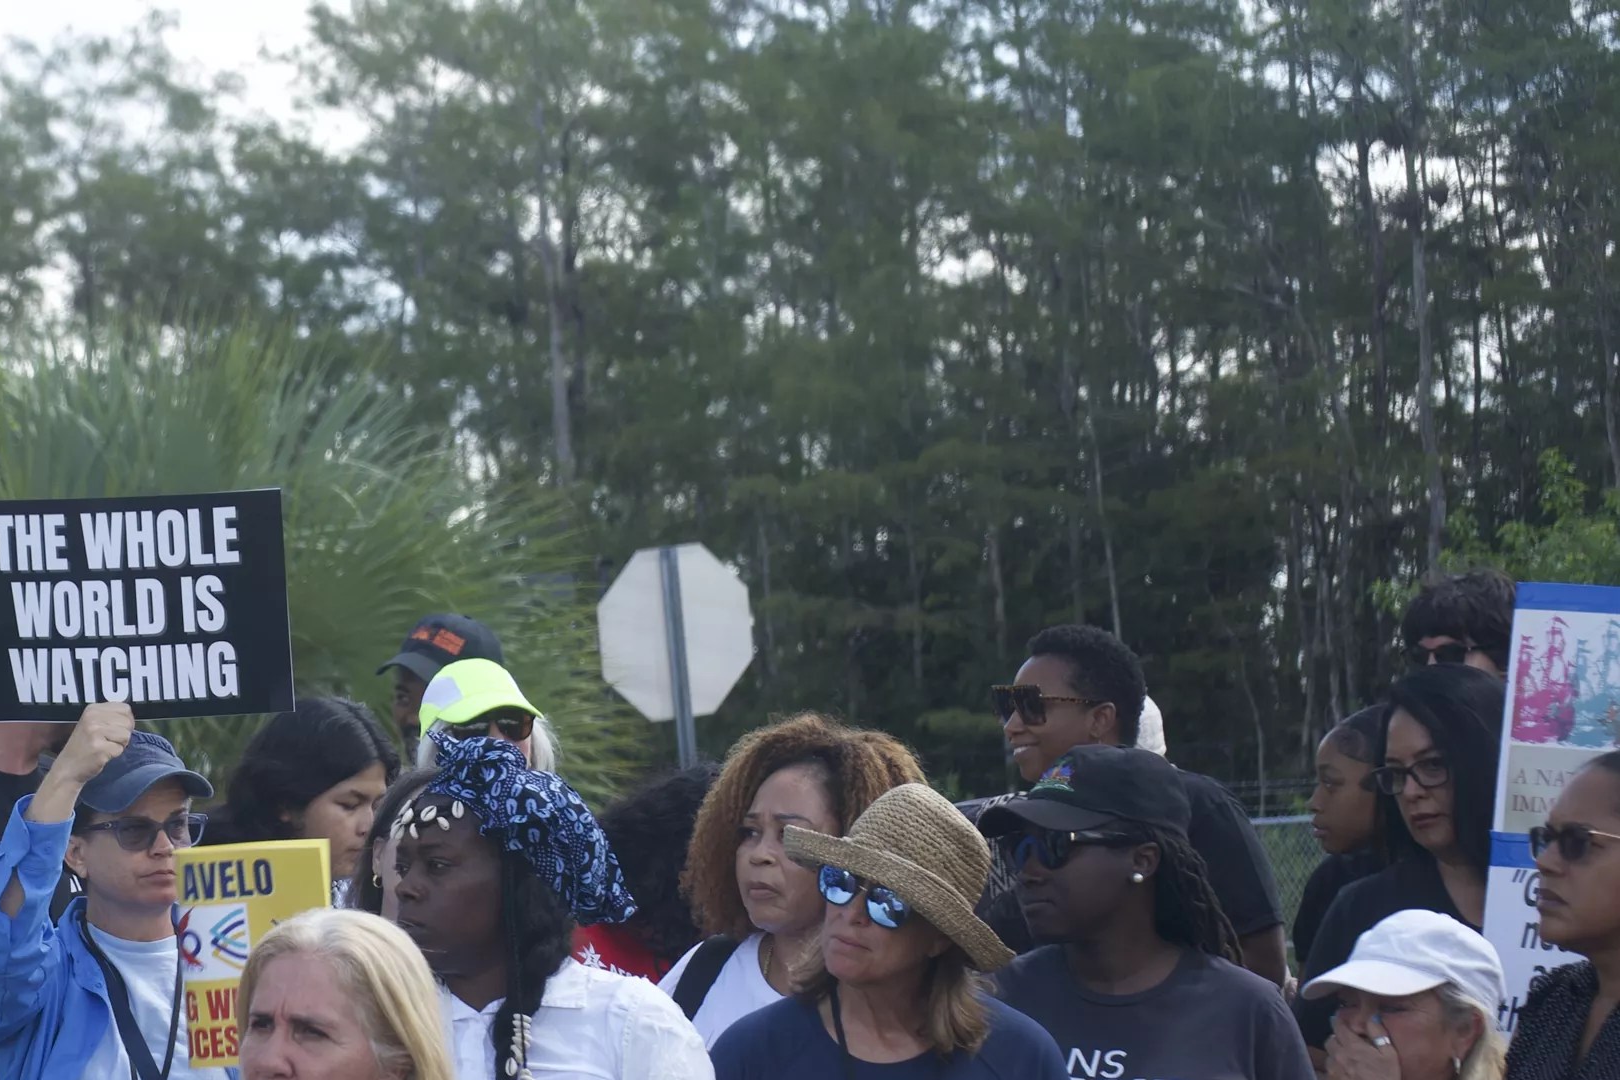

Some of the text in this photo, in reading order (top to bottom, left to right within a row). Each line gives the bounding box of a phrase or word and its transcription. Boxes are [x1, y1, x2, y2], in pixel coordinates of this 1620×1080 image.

[80, 506, 241, 570] WHOLE
[10, 574, 226, 640] WORLD IS
[8, 641, 239, 704] WATCHING
[183, 858, 274, 901] AVELO
[1067, 1048, 1127, 1078] NS
